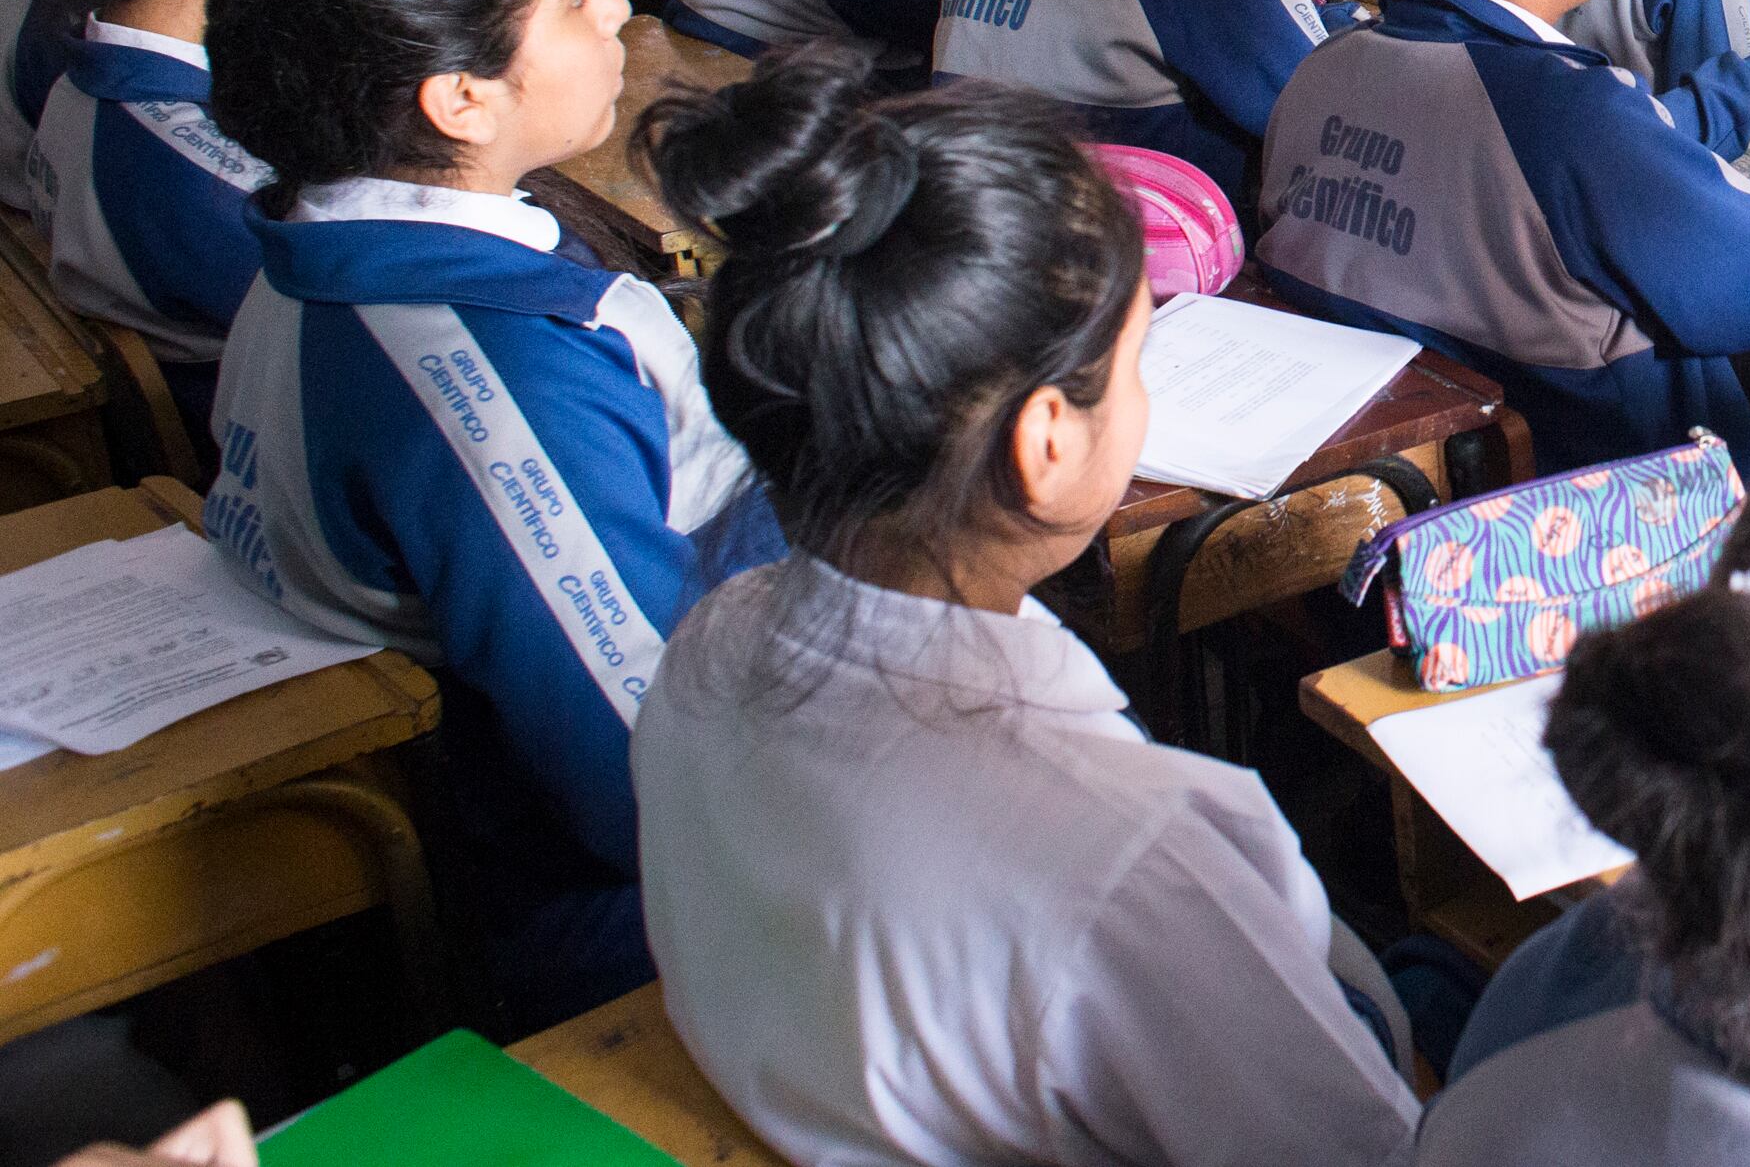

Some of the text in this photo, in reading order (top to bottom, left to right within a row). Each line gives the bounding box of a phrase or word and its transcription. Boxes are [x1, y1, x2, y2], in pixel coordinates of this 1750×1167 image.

[1320, 115, 1405, 176] Grupo
[450, 349, 495, 403] GRUPO
[490, 461, 560, 560] CIENTÍFICO
[521, 458, 564, 517] GRUPO
[558, 574, 624, 668] CIENTÍFICO
[590, 569, 627, 627] GRUPO
